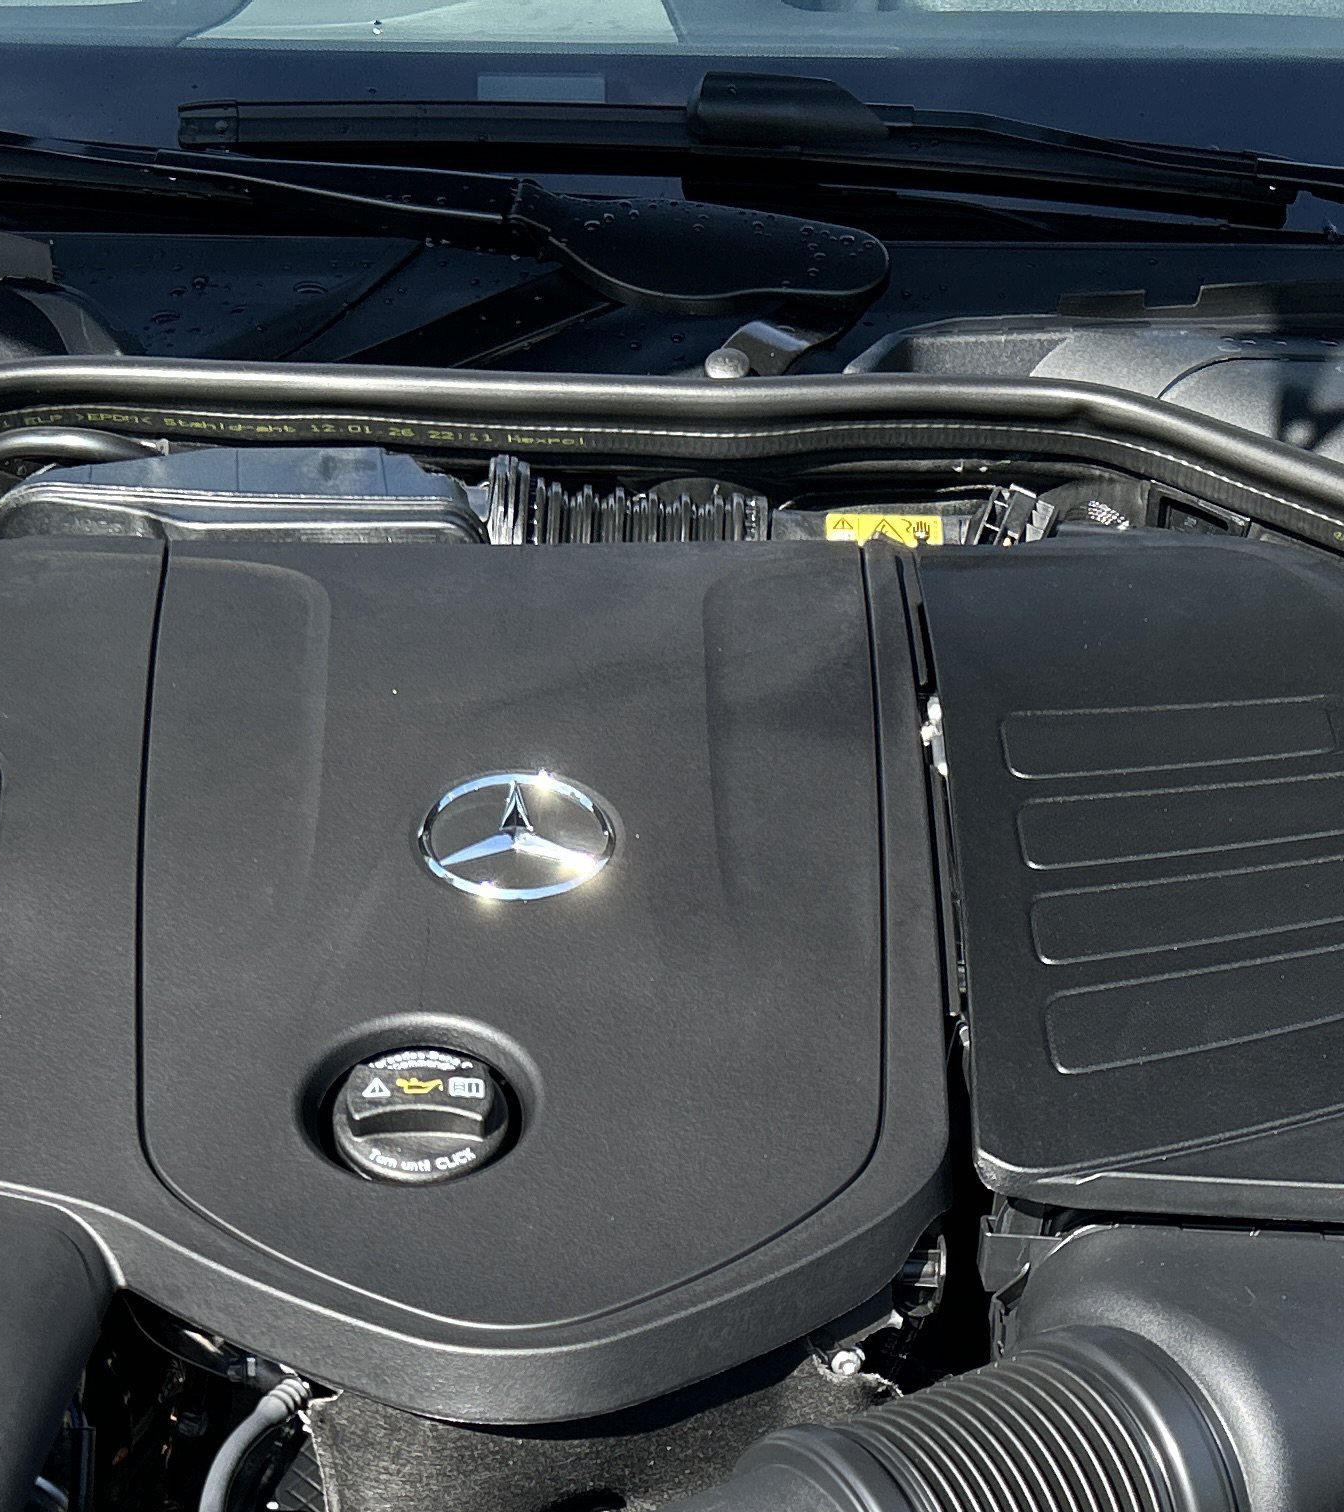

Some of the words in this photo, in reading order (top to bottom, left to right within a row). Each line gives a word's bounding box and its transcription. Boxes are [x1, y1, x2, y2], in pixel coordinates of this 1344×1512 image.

[368, 1147, 398, 1169] Turn
[400, 1158, 431, 1172] until
[435, 1146, 476, 1170] CLICK
